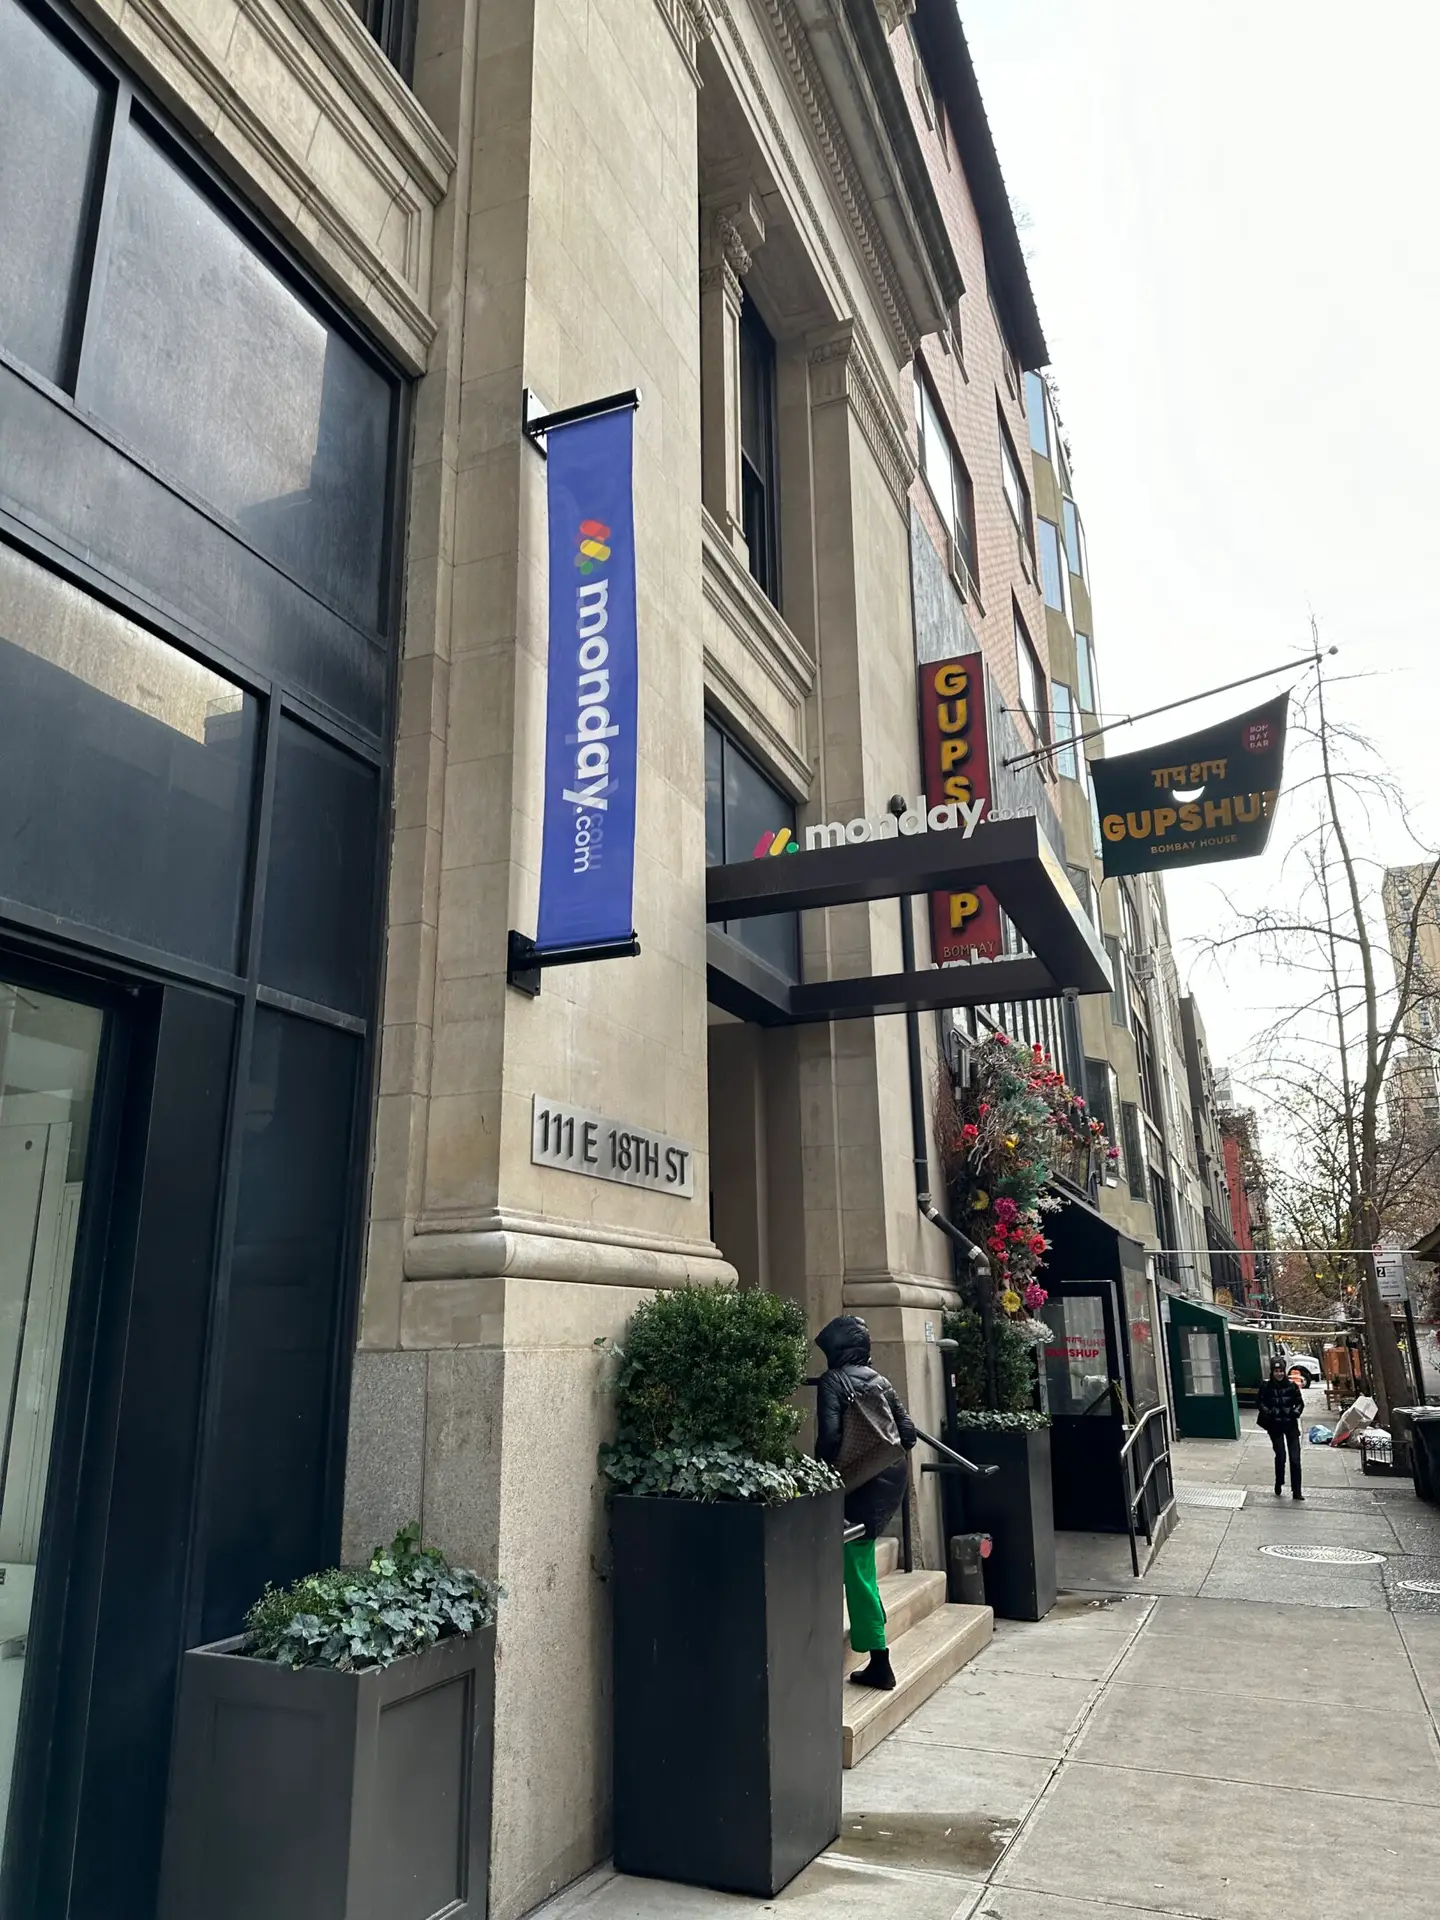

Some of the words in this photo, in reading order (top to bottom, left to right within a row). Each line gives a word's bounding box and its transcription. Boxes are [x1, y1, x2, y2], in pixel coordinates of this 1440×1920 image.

[563, 579, 620, 874] monday.com
[805, 795, 1037, 851] monday.com
[934, 664, 980, 929] GUPSP
[1151, 840, 1196, 854] BOMBAY
[1200, 834, 1238, 847] HOUSE
[538, 1110, 574, 1158] 111
[583, 1121, 598, 1163] E
[608, 1130, 659, 1178] 18TH
[666, 1147, 690, 1186] ST
